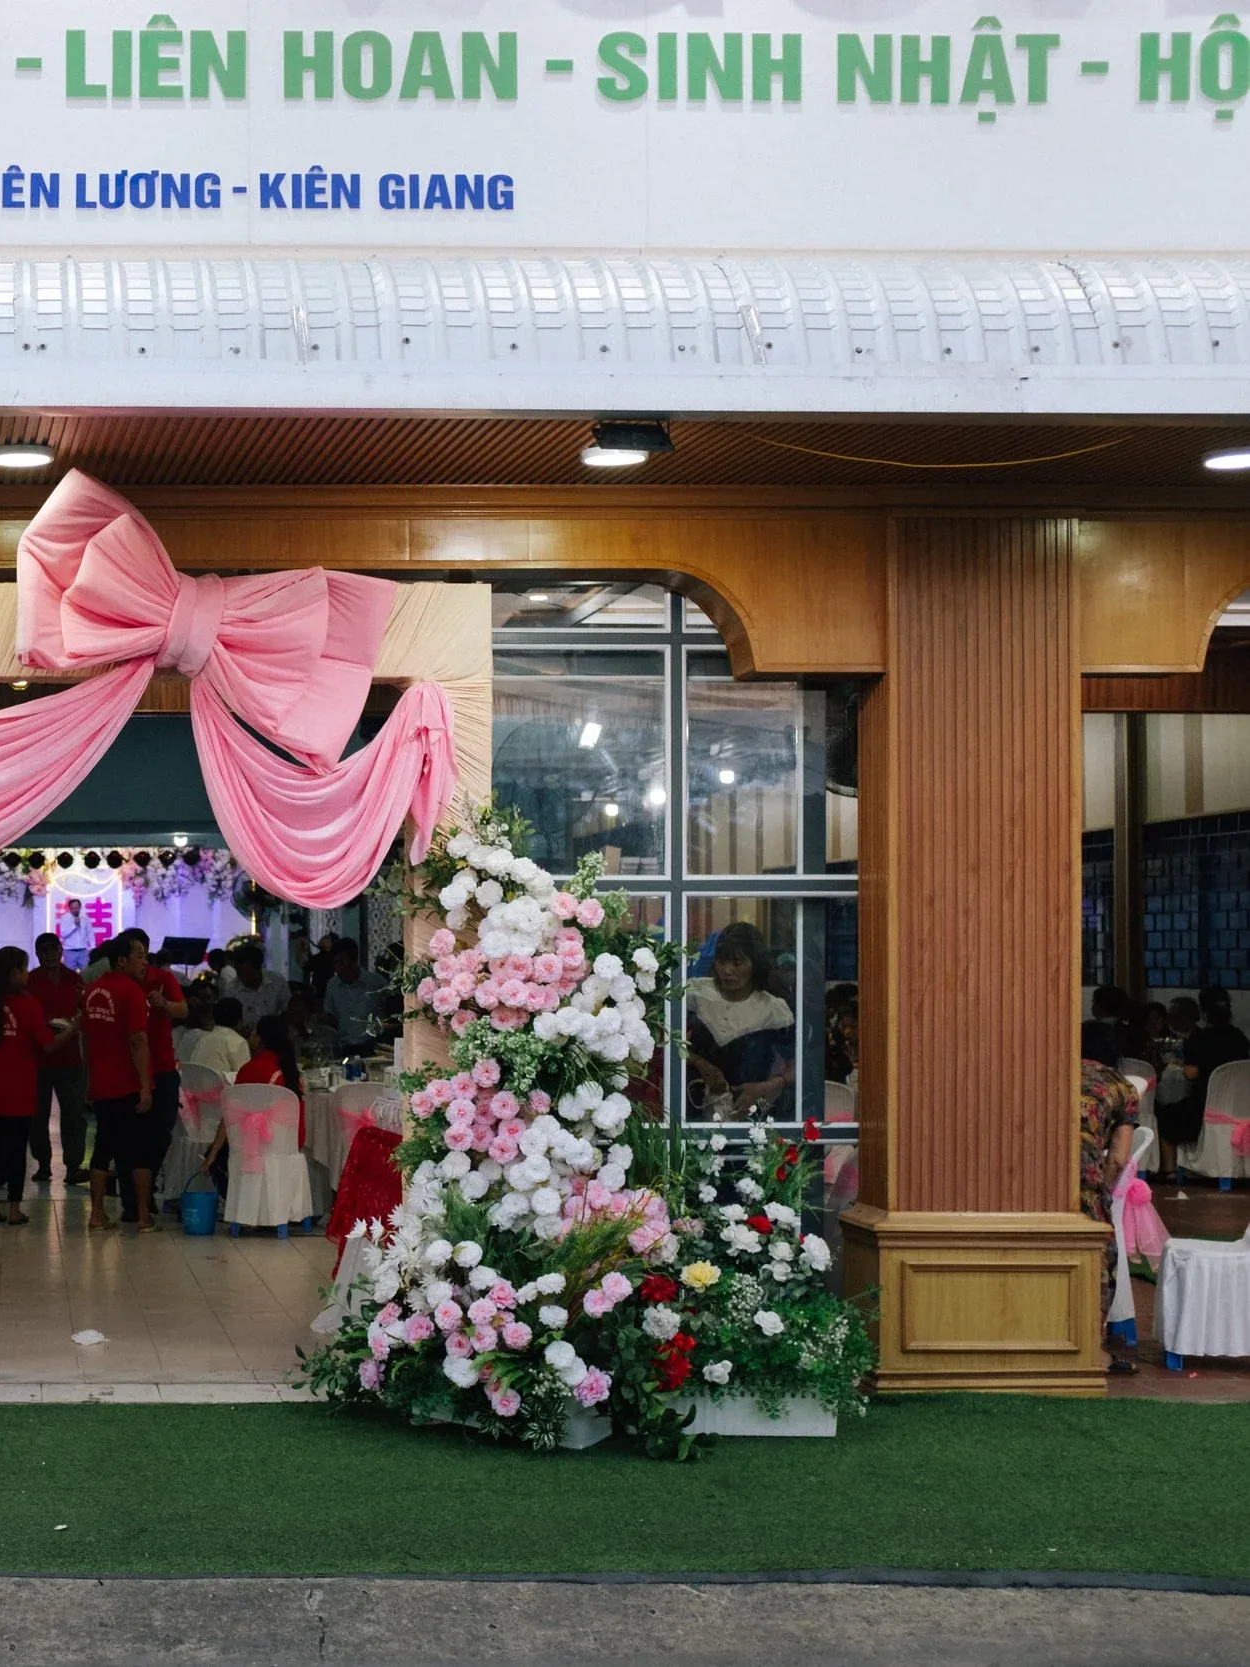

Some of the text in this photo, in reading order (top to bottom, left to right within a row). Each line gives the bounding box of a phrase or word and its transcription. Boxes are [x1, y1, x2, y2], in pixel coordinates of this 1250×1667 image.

[65, 14, 247, 100] LIÊN
[283, 30, 518, 101] HOAN
[596, 31, 803, 102] SINH
[836, 16, 1061, 122] NHẬT
[75, 168, 222, 210] LƯƠNG
[258, 165, 362, 210] KIÊN
[378, 173, 515, 211] GIANG
